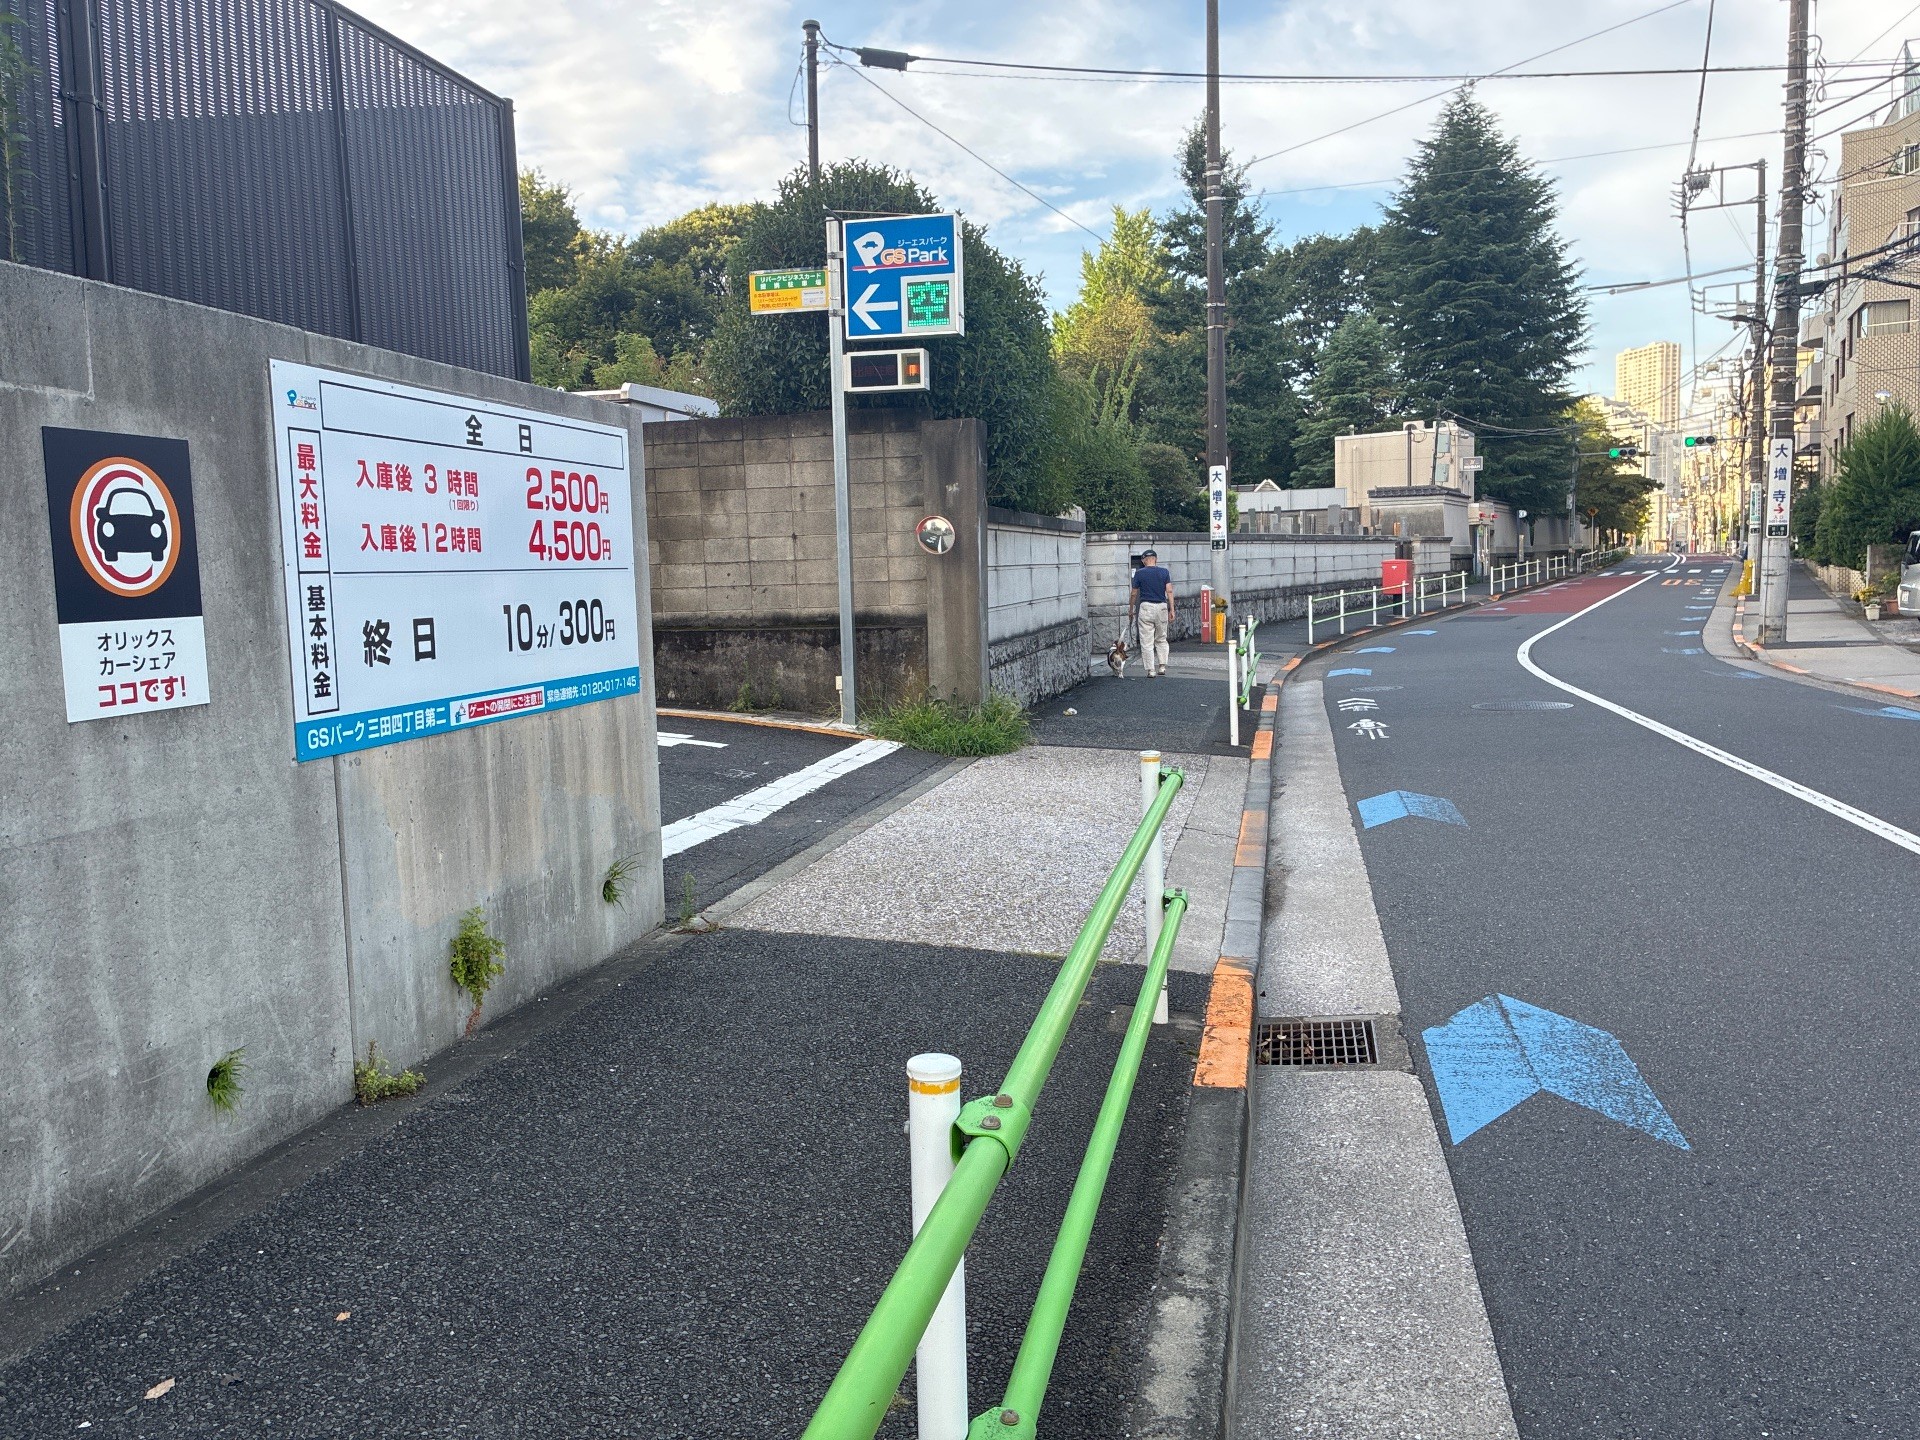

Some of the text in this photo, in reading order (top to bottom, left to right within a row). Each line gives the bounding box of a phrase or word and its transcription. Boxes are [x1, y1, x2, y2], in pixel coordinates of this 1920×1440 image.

[898, 236, 947, 247] ジーエスパーク
[908, 246, 948, 263] Park
[526, 467, 609, 514] 2,500円
[1773, 444, 1788, 503] 大増寺
[297, 443, 322, 558] 最大料金
[1212, 471, 1222, 521] 大増寺
[529, 519, 611, 561] 4,500円
[97, 629, 175, 652] オリックス
[307, 585, 331, 698] 基本料金
[100, 652, 176, 676] カーシェア
[98, 676, 186, 707] ココです!
